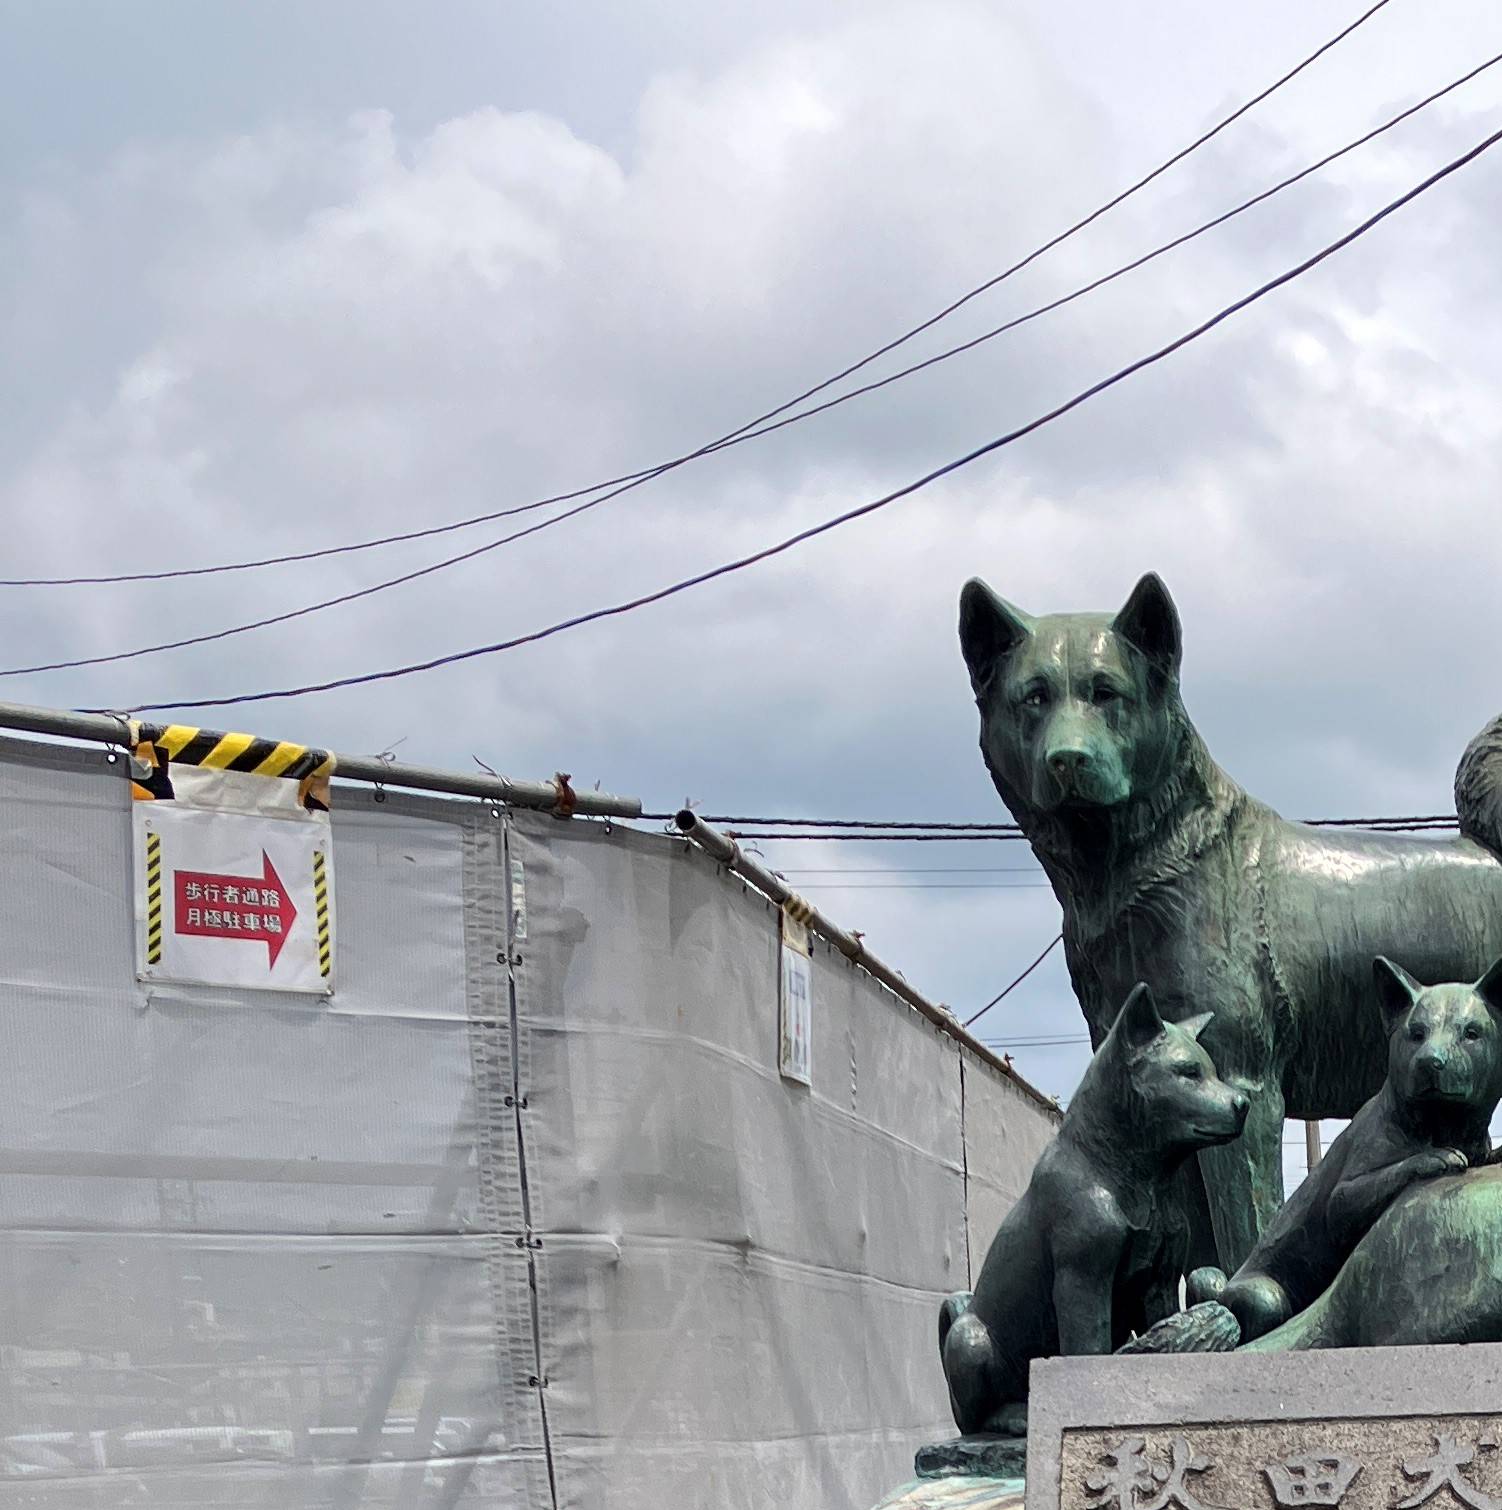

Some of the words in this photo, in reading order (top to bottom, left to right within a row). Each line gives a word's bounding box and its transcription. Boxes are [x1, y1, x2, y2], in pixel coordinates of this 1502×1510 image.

[185, 882, 281, 908] 歩行者通路
[186, 907, 282, 933] 月極駐車場
